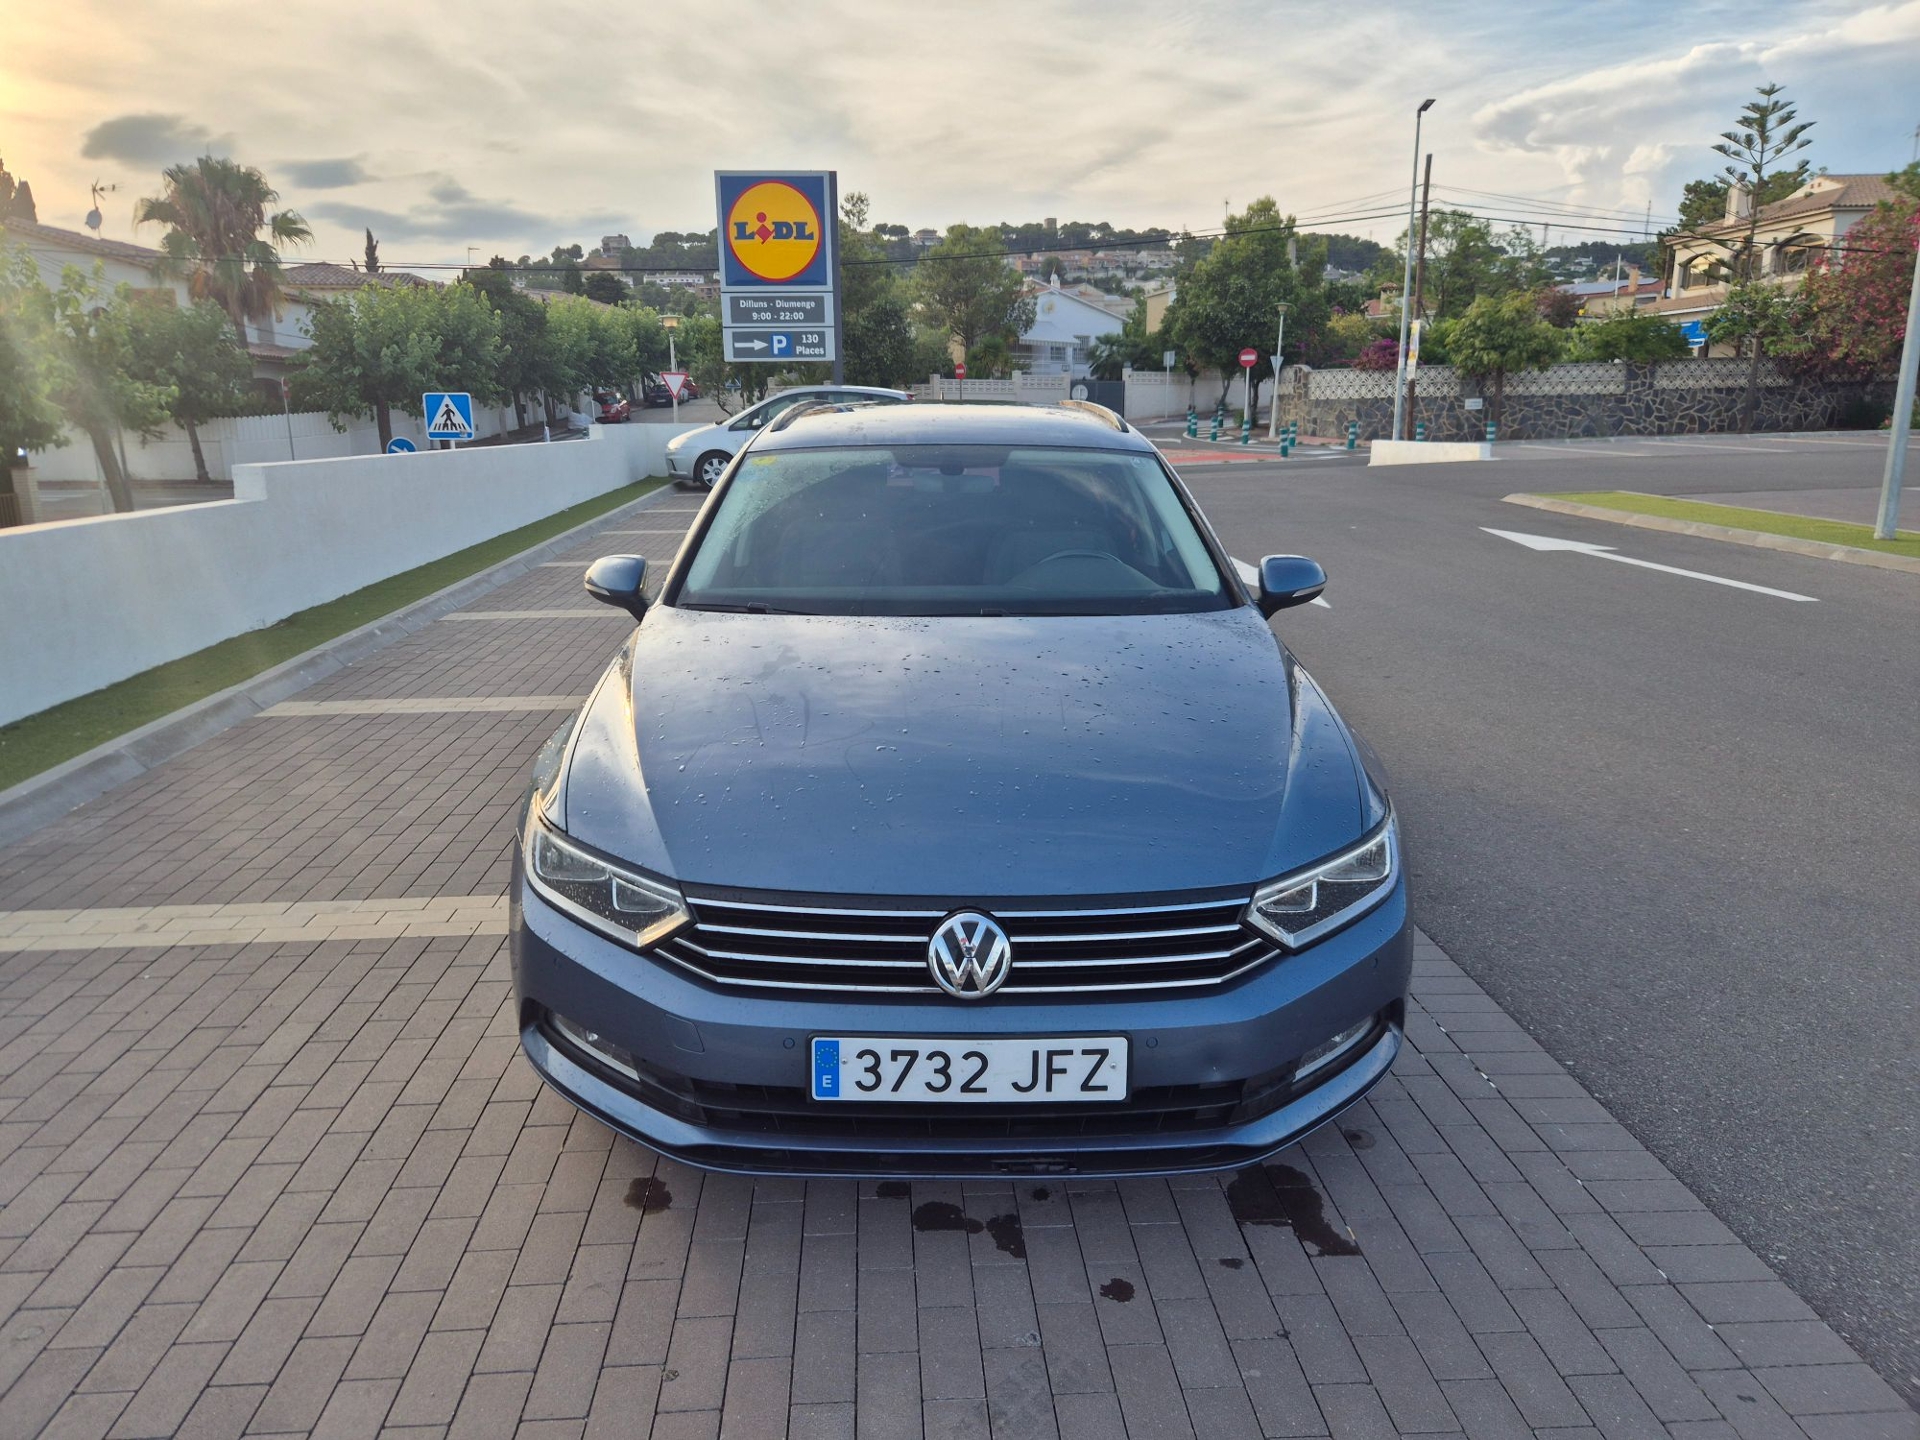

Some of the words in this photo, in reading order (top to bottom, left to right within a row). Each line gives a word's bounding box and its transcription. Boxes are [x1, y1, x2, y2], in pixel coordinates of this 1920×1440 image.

[739, 299, 768, 308] Dilluns
[775, 299, 816, 310] Diumenge
[752, 312, 772, 321] 9:00
[779, 312, 805, 321] 22:00
[801, 334, 819, 344] 130
[772, 335, 787, 355] P
[795, 345, 825, 355] Places
[855, 1049, 989, 1093] 3732
[1011, 1048, 1110, 1093] JFZ
[822, 1075, 832, 1088] E
